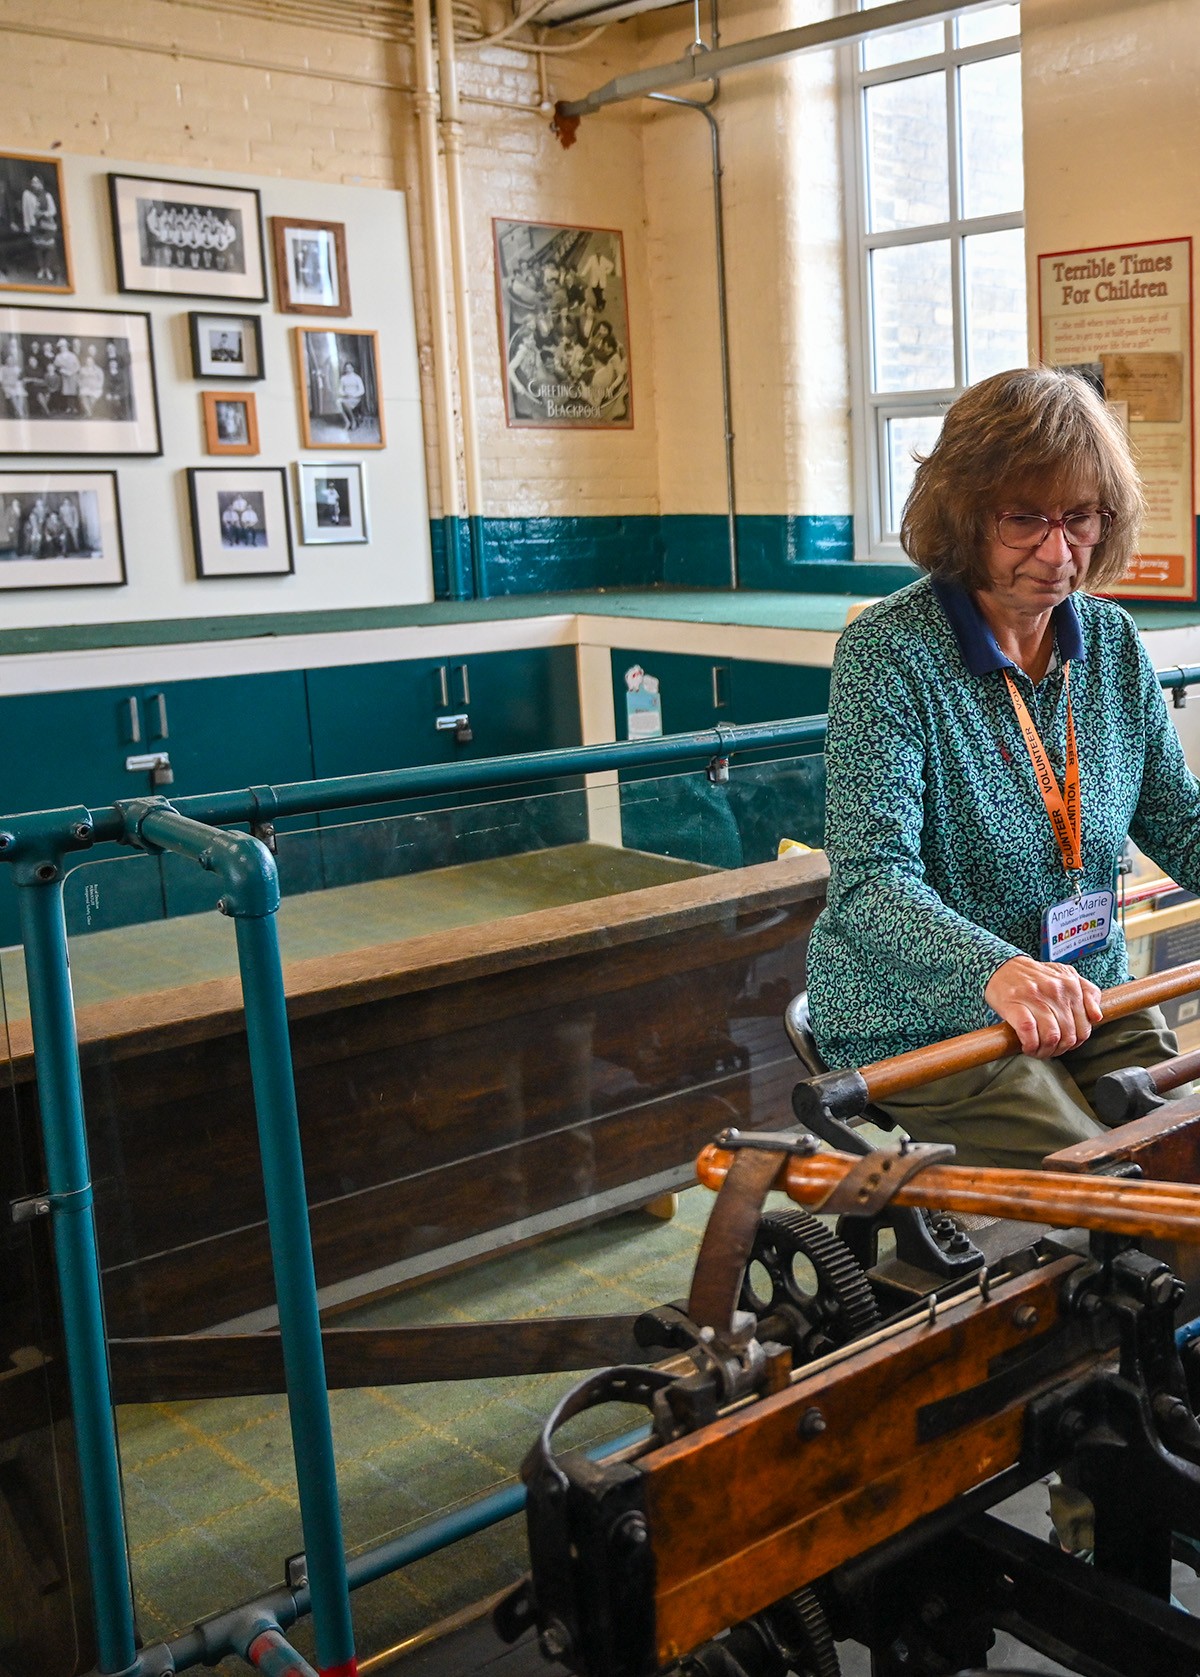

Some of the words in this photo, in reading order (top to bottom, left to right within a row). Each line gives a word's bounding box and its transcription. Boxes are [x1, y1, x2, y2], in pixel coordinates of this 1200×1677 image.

[1053, 258, 1116, 282] Terrible
[1120, 254, 1173, 275] Times
[1062, 285, 1090, 305] For
[1095, 279, 1168, 302] Children
[1025, 727, 1053, 793] VOLUNTEER
[1051, 895, 1108, 924] Anne-Marie
[1052, 918, 1105, 945] BRADFORD
[1078, 932, 1103, 943] GALLERIES
